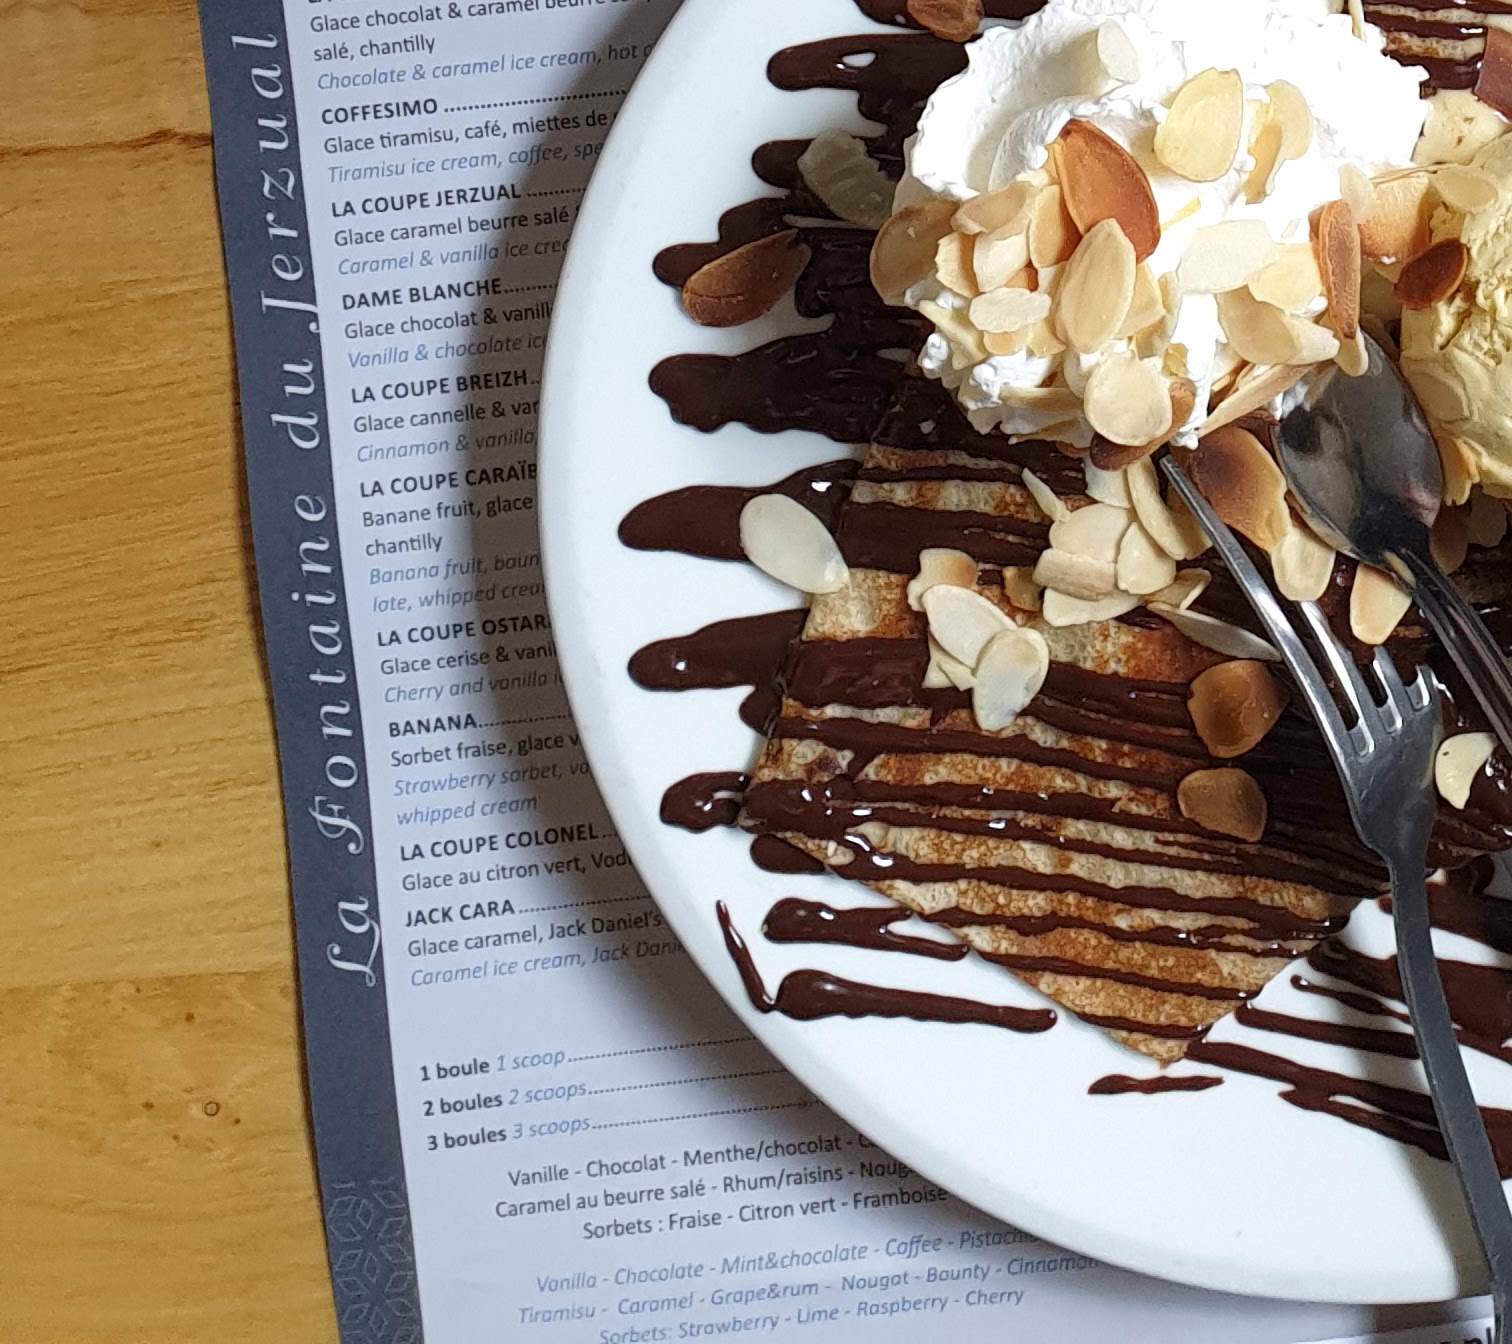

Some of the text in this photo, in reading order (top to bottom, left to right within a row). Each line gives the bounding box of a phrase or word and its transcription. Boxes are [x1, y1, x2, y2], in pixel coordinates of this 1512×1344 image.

[309, 14, 361, 33] Glace
[365, 4, 443, 27] chocolat
[447, 2, 463, 19] &
[313, 33, 435, 62] salé, chantilly
[321, 98, 438, 125] COFFESIMO
[351, 368, 533, 404] LA COUPE BREIZH
[231, 33, 381, 987] La Fontaine du Jerzual
[388, 713, 478, 738] BANANA
[400, 823, 600, 862] LA COUPE COLONEL
[420, 1050, 567, 1082] 1 boule 1 scoop
[507, 1134, 842, 1187] Vanille Chocolat Menthe/chocolat
